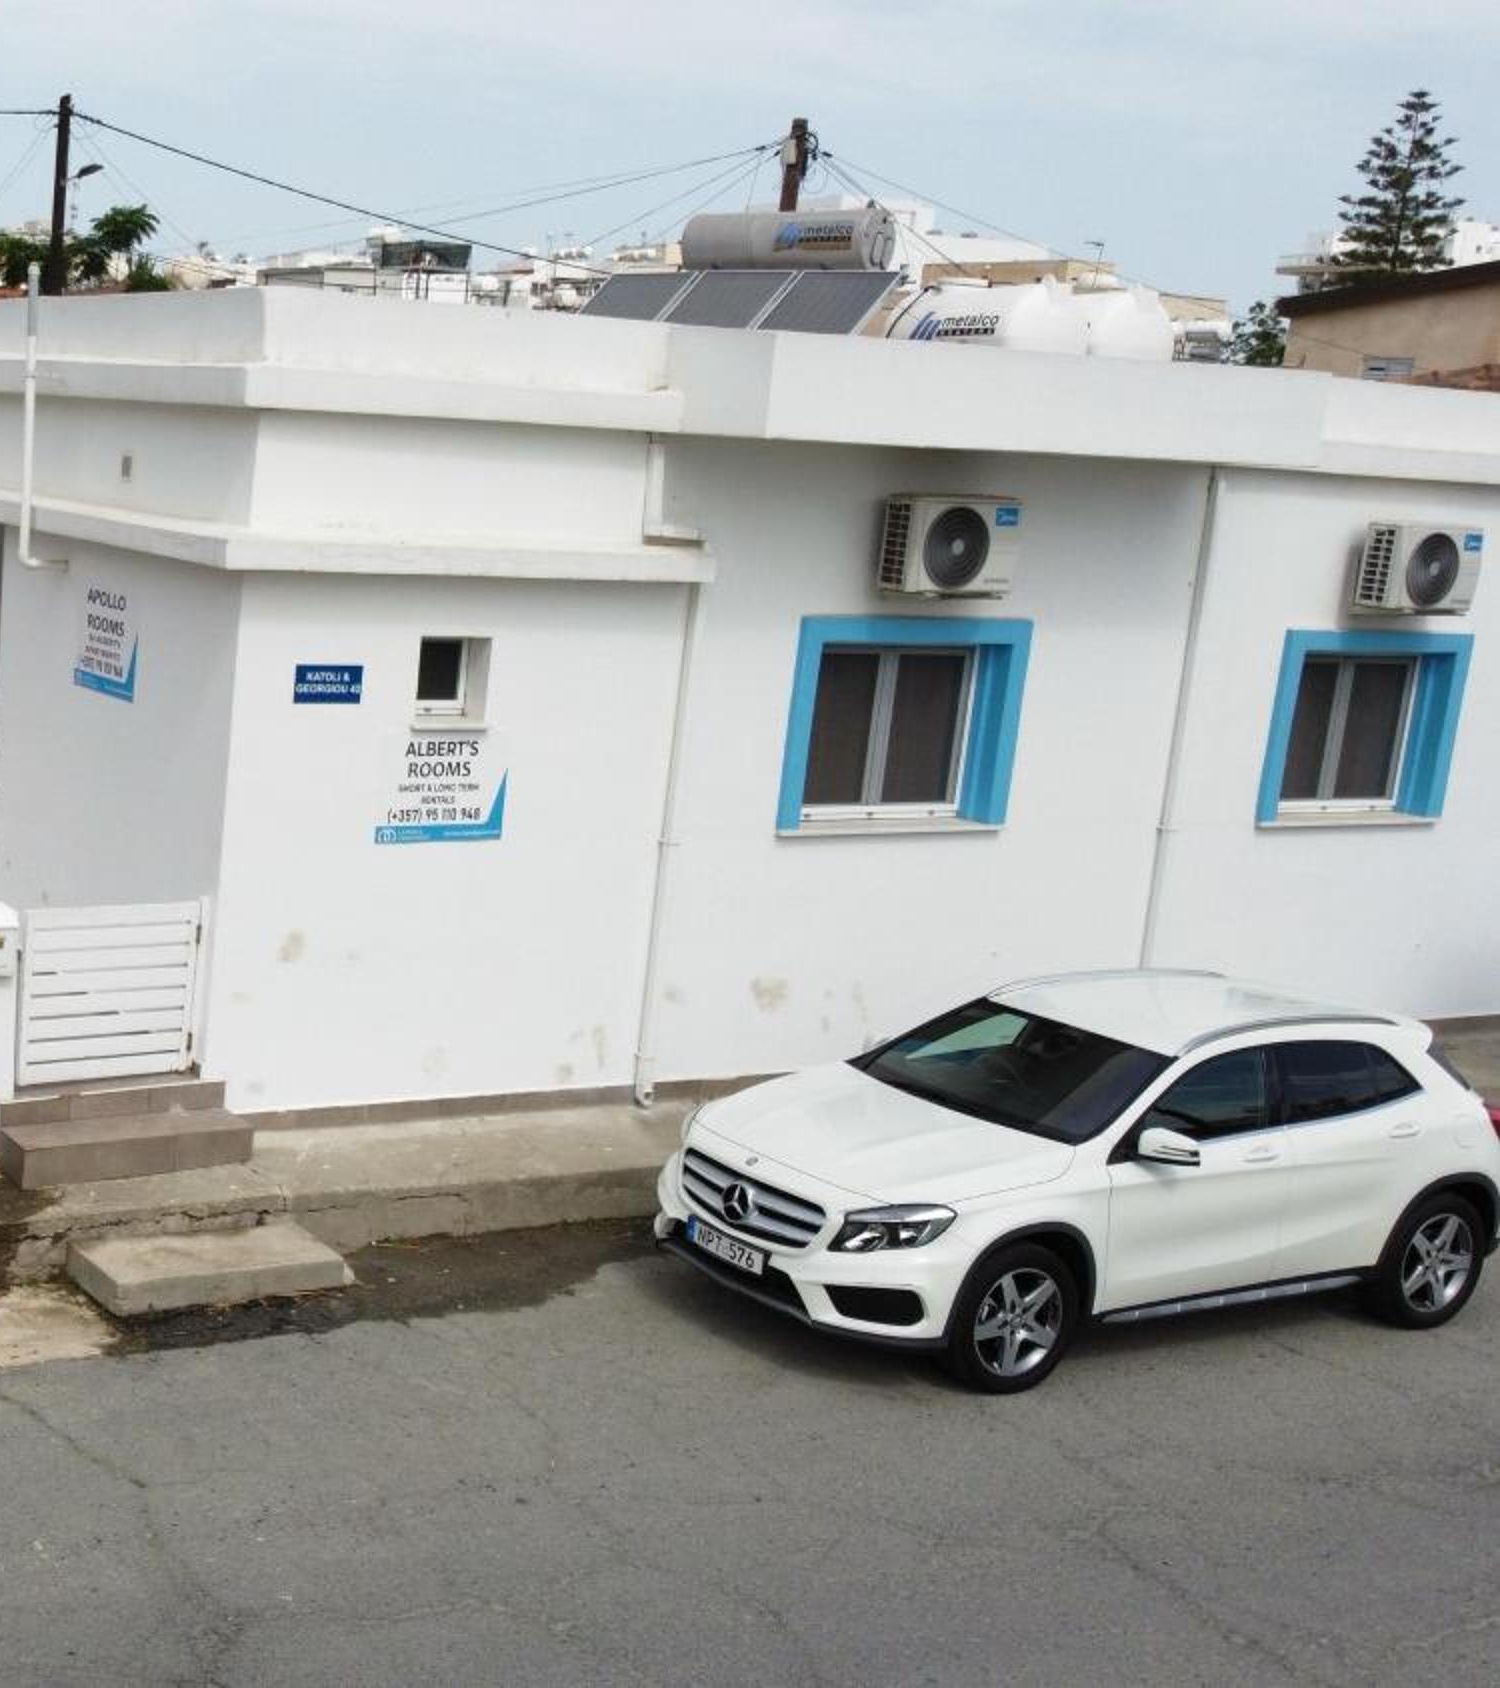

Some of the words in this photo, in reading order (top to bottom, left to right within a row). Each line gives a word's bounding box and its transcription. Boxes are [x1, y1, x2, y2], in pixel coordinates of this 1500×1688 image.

[941, 313, 999, 327] metalco
[87, 588, 127, 611] APOLLO
[87, 613, 125, 637] ROOMS
[405, 740, 479, 757] ALBERT'S
[407, 761, 471, 778] ROOMS
[387, 808, 422, 824] (+357)
[425, 807, 439, 821] 95
[729, 1242, 755, 1268] 576
